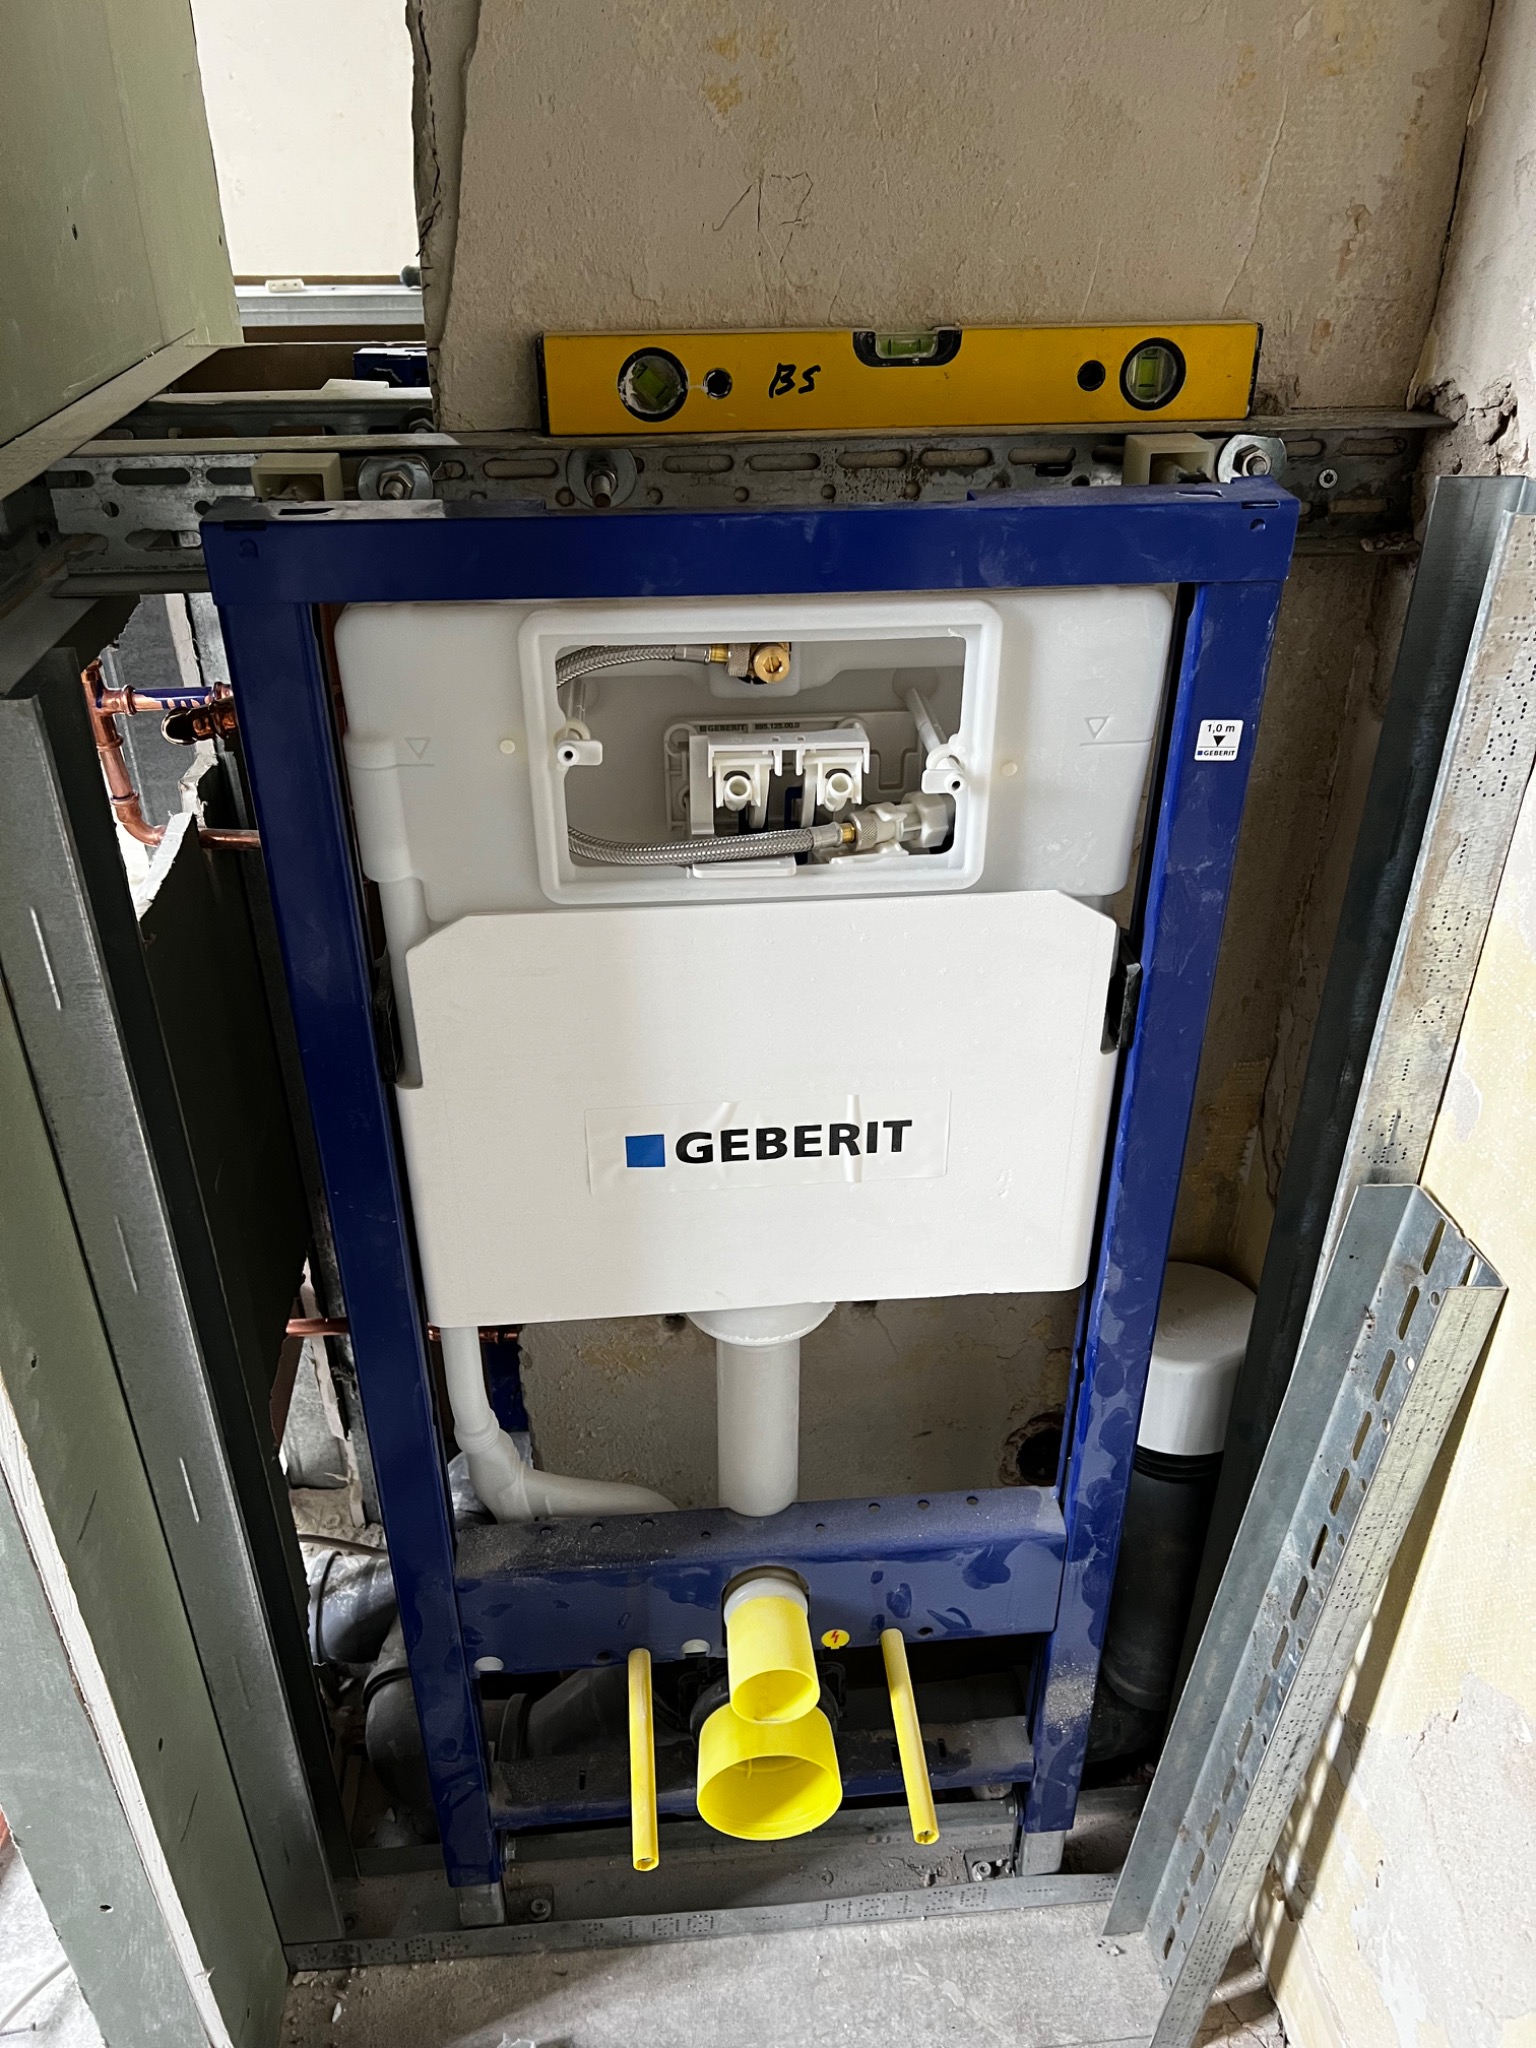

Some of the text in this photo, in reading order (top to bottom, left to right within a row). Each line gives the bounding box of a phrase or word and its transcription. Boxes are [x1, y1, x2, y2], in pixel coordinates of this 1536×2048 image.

[768, 362, 822, 399] BS
[1207, 723, 1223, 733] 1,0
[675, 1119, 913, 1164] GEBERIT
